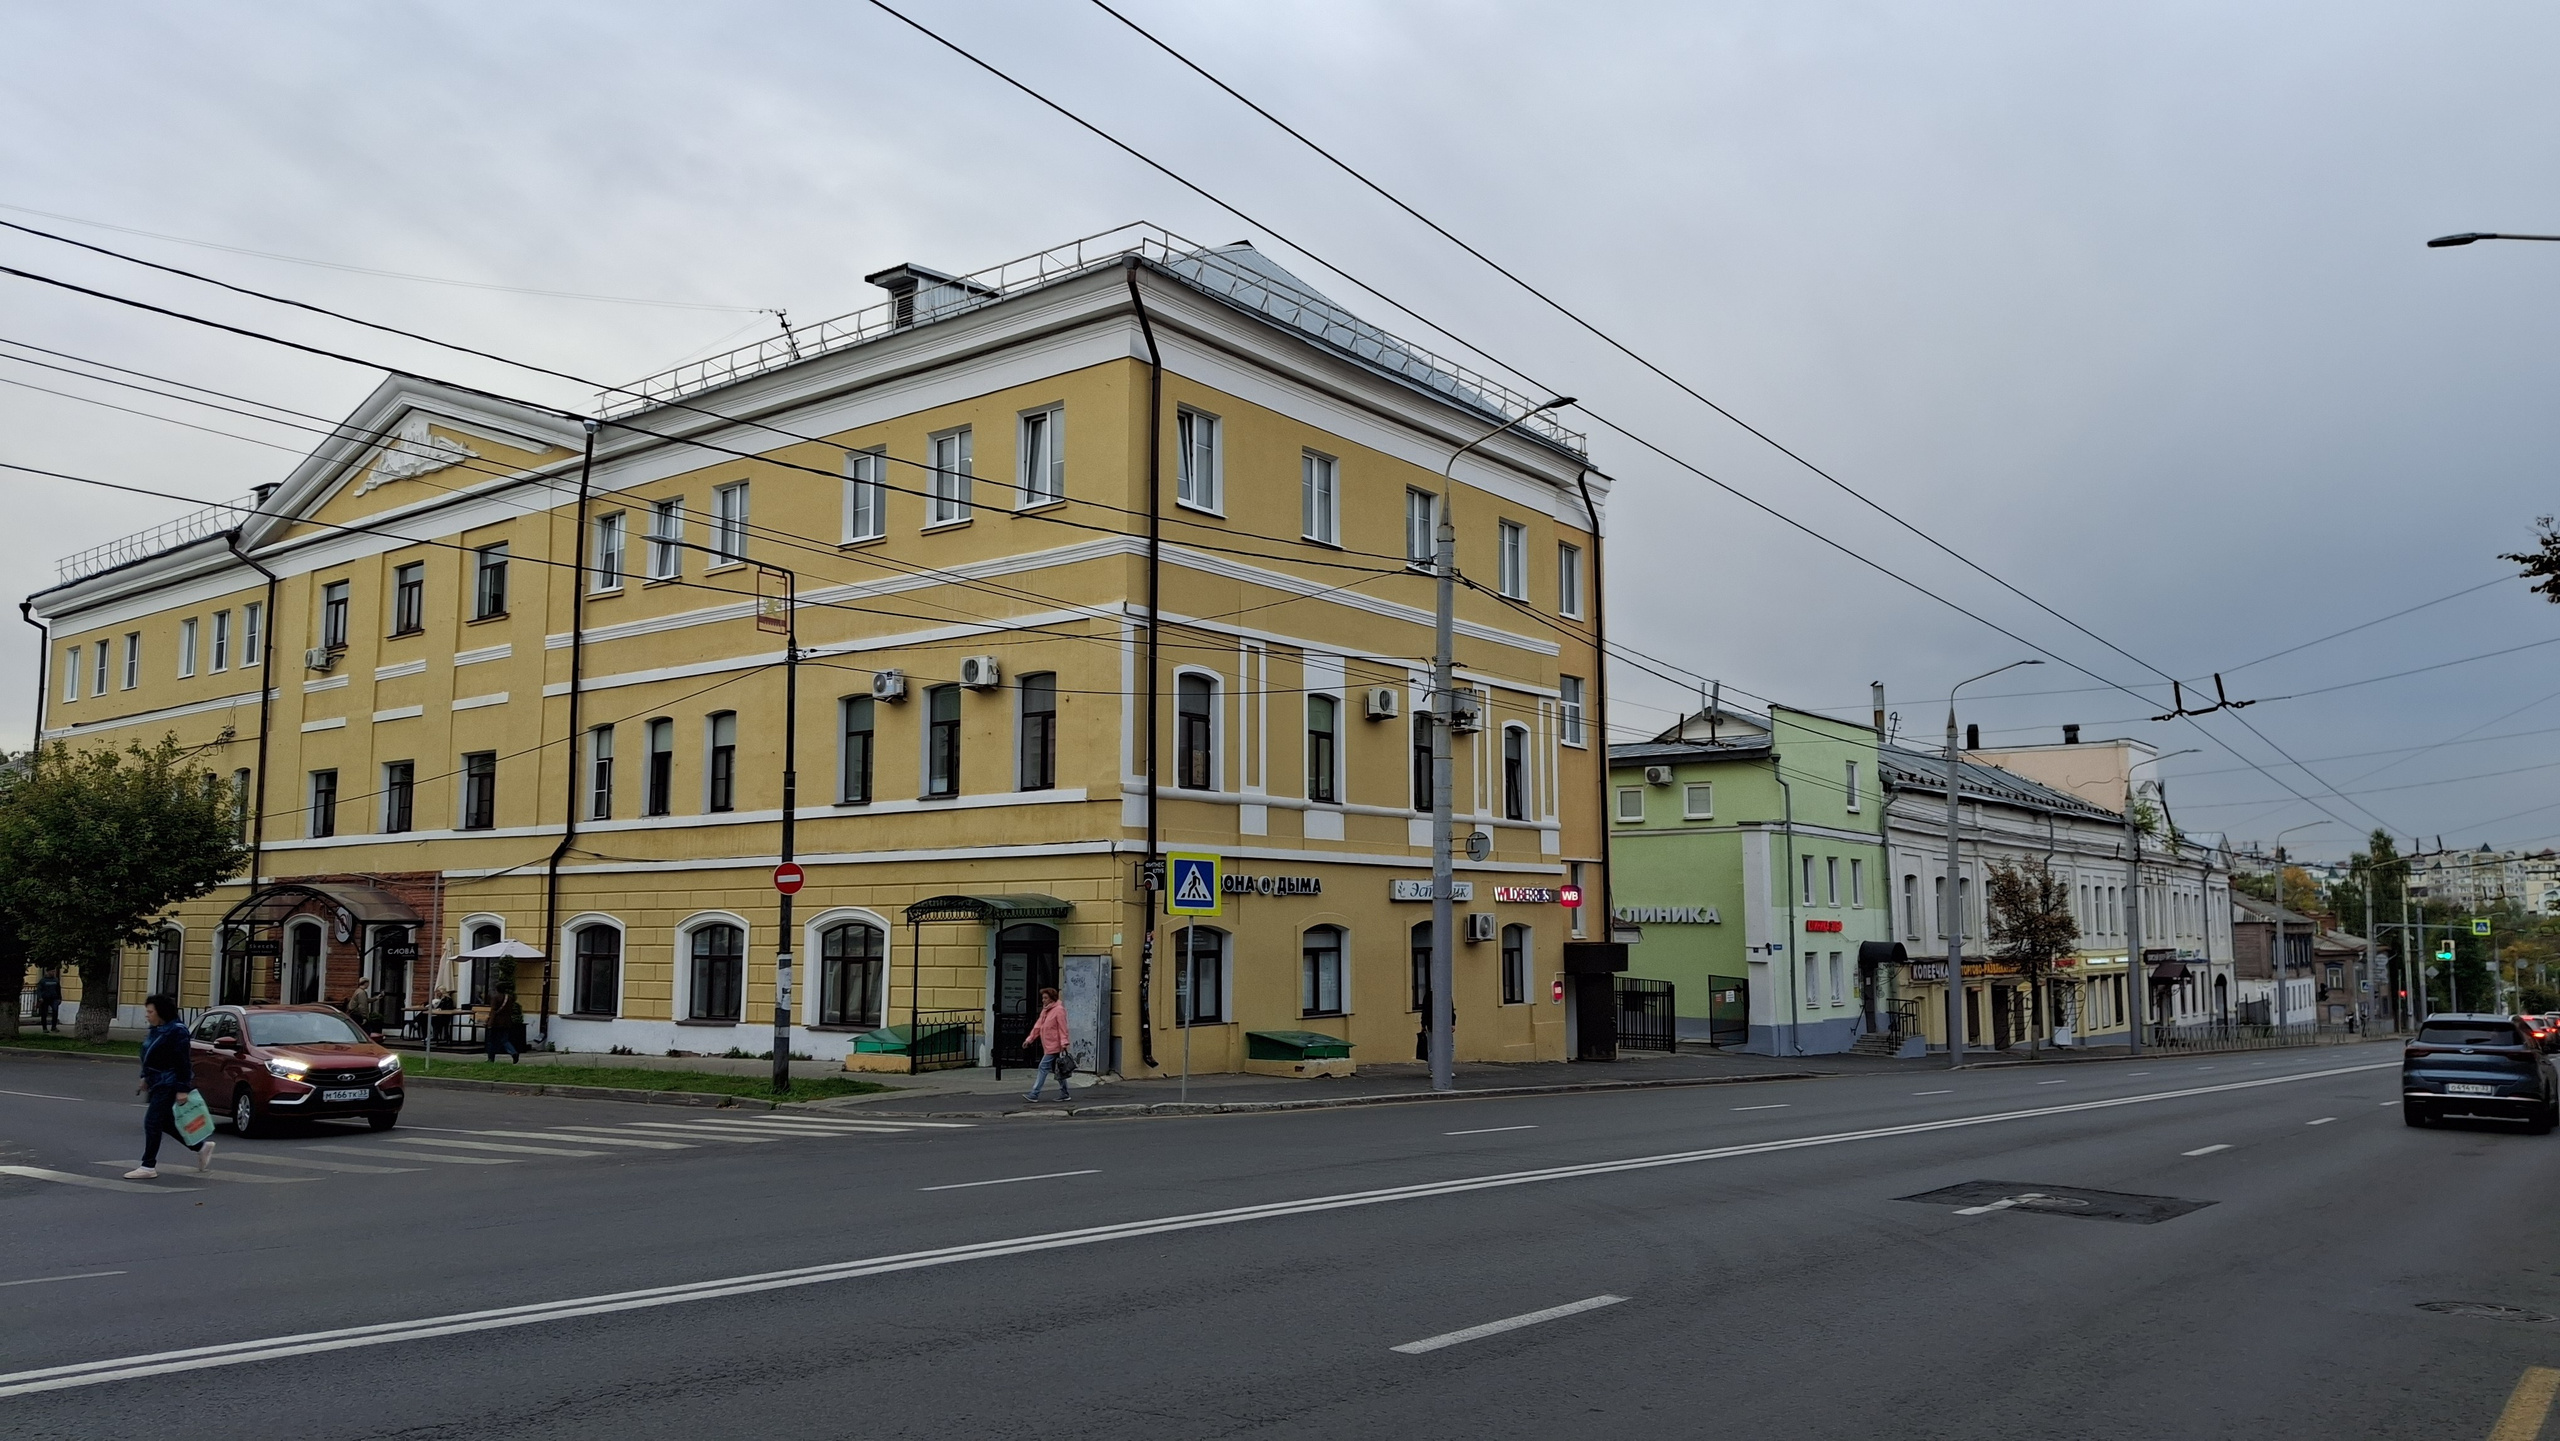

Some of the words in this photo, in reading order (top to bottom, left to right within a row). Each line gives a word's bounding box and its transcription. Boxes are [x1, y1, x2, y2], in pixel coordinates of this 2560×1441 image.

[1220, 874, 1255, 892] ОНА
[1275, 877, 1322, 895] ДЫМА
[1493, 886, 1550, 902] WILDBERRIES
[1561, 891, 1579, 902] WB
[1613, 906, 1721, 924] КЛИНИКА
[1912, 963, 1950, 980] КОПЕЕЧКА
